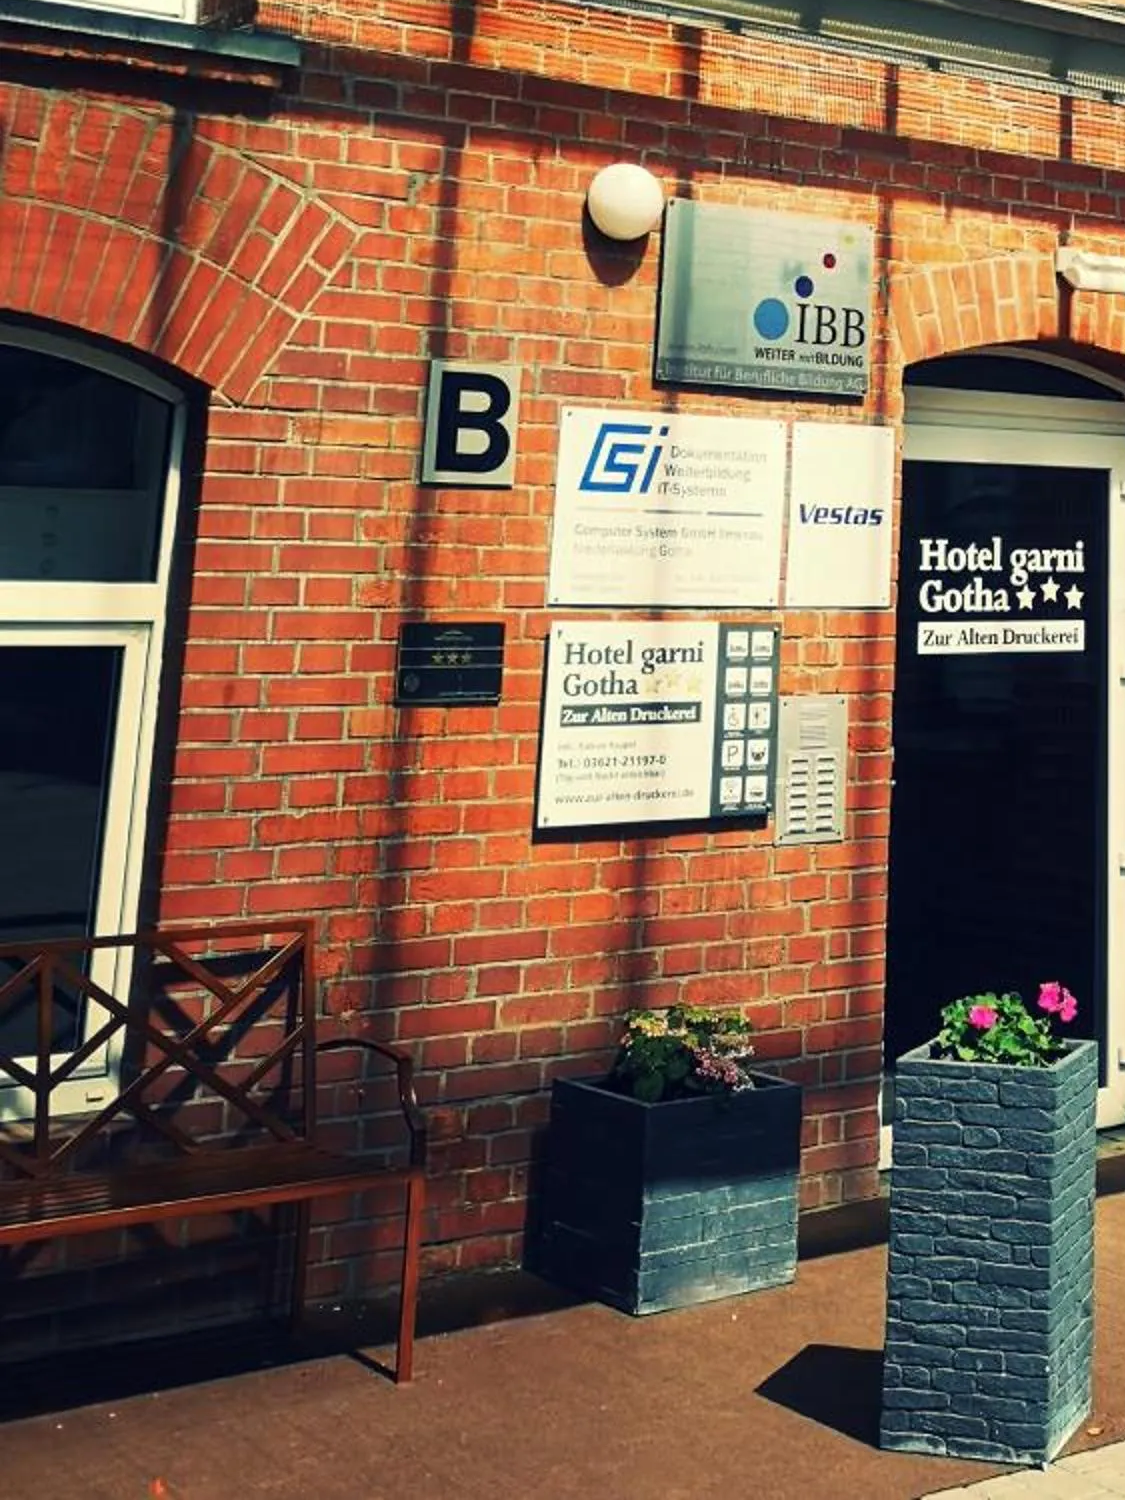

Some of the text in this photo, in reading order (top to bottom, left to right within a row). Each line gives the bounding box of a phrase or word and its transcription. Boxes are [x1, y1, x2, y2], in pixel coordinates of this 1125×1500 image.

[794, 304, 865, 348] IBB
[754, 347, 795, 361] WEITER
[815, 353, 863, 367] BILDUNG
[665, 361, 711, 377] Ititut
[714, 364, 732, 378] für
[735, 368, 795, 385] Berufliche
[434, 371, 511, 474] B
[799, 503, 884, 526] Vestas
[635, 525, 678, 541] System
[919, 536, 1084, 585] Hotel garni
[919, 577, 1011, 612] Gotha
[923, 627, 1079, 646] Zur Alten Druckerei
[564, 639, 704, 674] Hotel garni
[563, 670, 639, 696] Gotha
[562, 706, 697, 723] Zur Alten Druckerei
